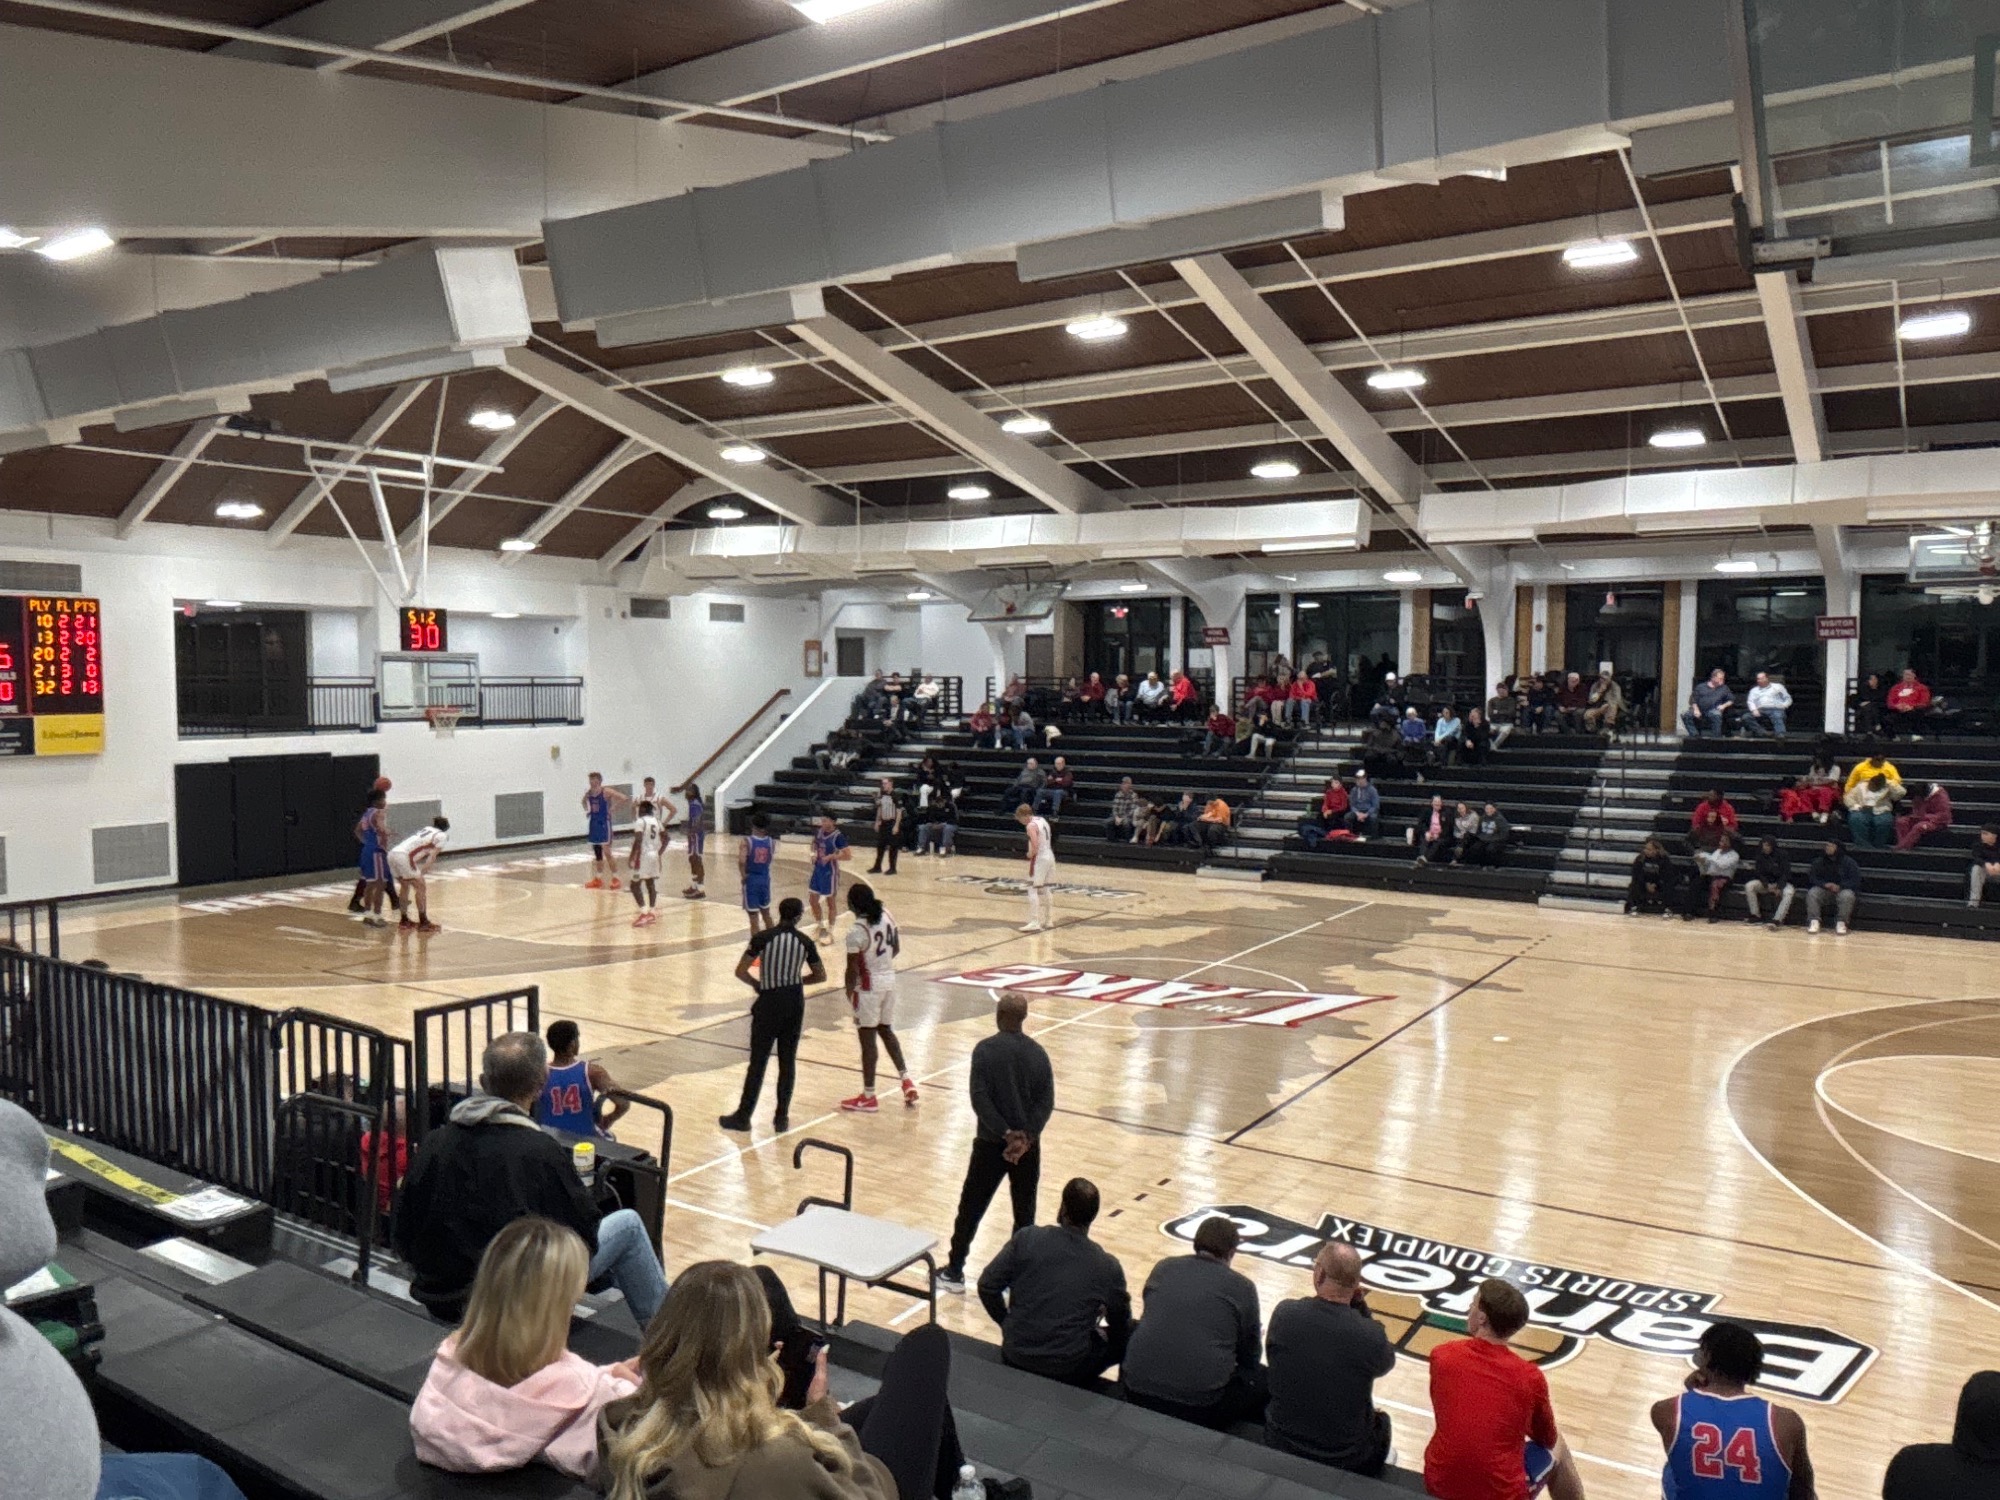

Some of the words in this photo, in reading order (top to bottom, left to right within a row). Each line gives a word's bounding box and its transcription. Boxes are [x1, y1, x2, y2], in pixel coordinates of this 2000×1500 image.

[29, 600, 51, 612] PLY
[56, 600, 71, 612] FL
[74, 602, 96, 613] PTS
[37, 614, 53, 628] 10
[58, 614, 69, 628] 2
[74, 614, 96, 628] 21
[37, 630, 54, 644] 13
[59, 630, 70, 644] 2
[75, 630, 96, 645] 20
[411, 624, 439, 649] 30
[33, 647, 54, 661] 20
[60, 647, 71, 661] 2
[86, 647, 97, 661] 2
[33, 664, 55, 678] 21
[61, 664, 72, 678] 3
[86, 664, 97, 678] 0
[36, 680, 55, 695] 32
[61, 680, 72, 694] 2
[82, 680, 98, 694] 13
[874, 923, 900, 958] 24
[926, 963, 1399, 1028] LAKE
[550, 1083, 582, 1116] 14
[1331, 1217, 1512, 1278] COMPLEX
[1518, 1265, 1702, 1313] SPORTS
[1691, 1421, 1762, 1484] 24
